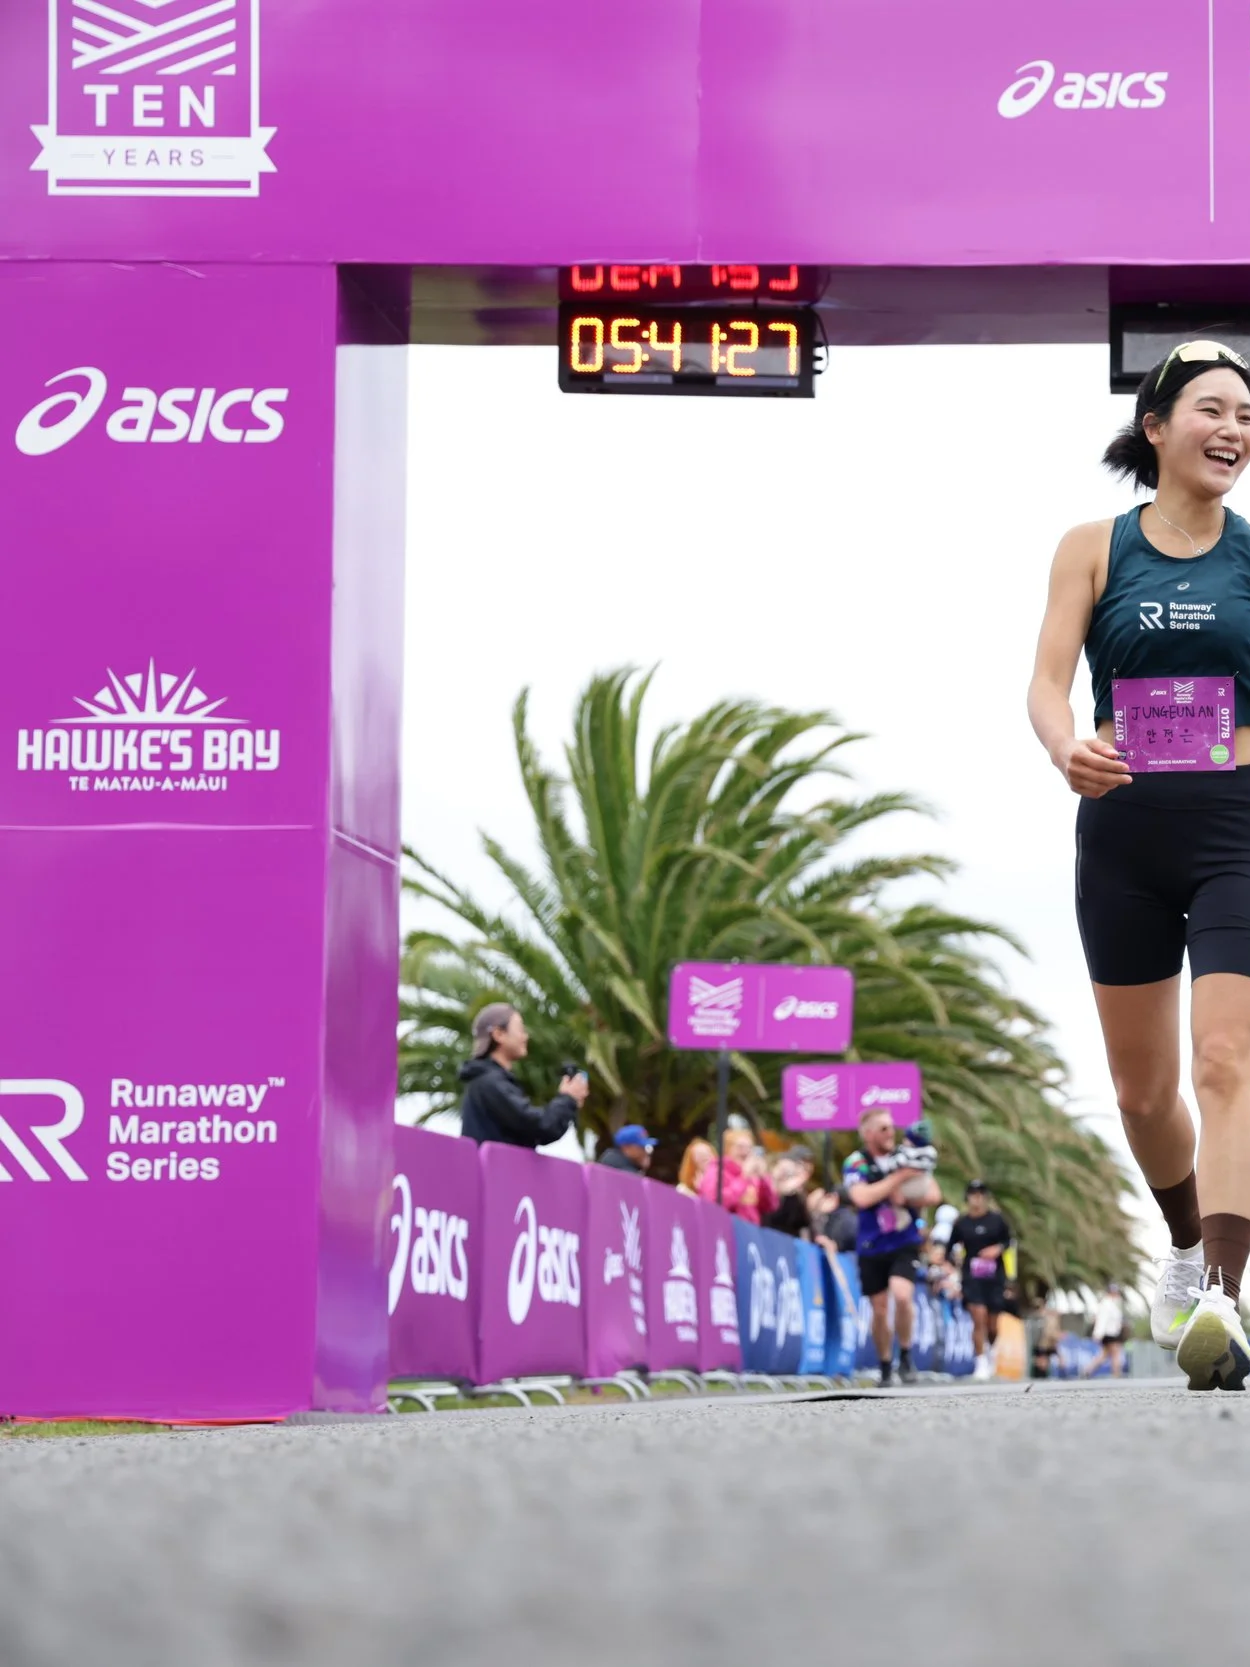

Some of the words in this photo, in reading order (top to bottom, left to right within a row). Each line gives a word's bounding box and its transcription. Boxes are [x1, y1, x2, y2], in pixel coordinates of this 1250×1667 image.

[1053, 70, 1169, 109] asics
[84, 84, 215, 128] TEN
[103, 149, 205, 166] YEARS
[570, 316, 799, 376] 05:41:27
[105, 387, 289, 443] asics
[1169, 611, 1216, 621] Marathon
[1169, 620, 1201, 630] Series
[1114, 710, 1124, 741] 01778
[1198, 705, 1214, 719] AN
[1220, 707, 1231, 739] 01778
[17, 728, 193, 771] HAWKE'S
[203, 728, 280, 771] BAY
[69, 776, 89, 791] TE
[109, 1114, 278, 1144] Marathon
[106, 1151, 220, 1182] Series
[411, 1206, 468, 1301] asics
[537, 1225, 581, 1307] asics
